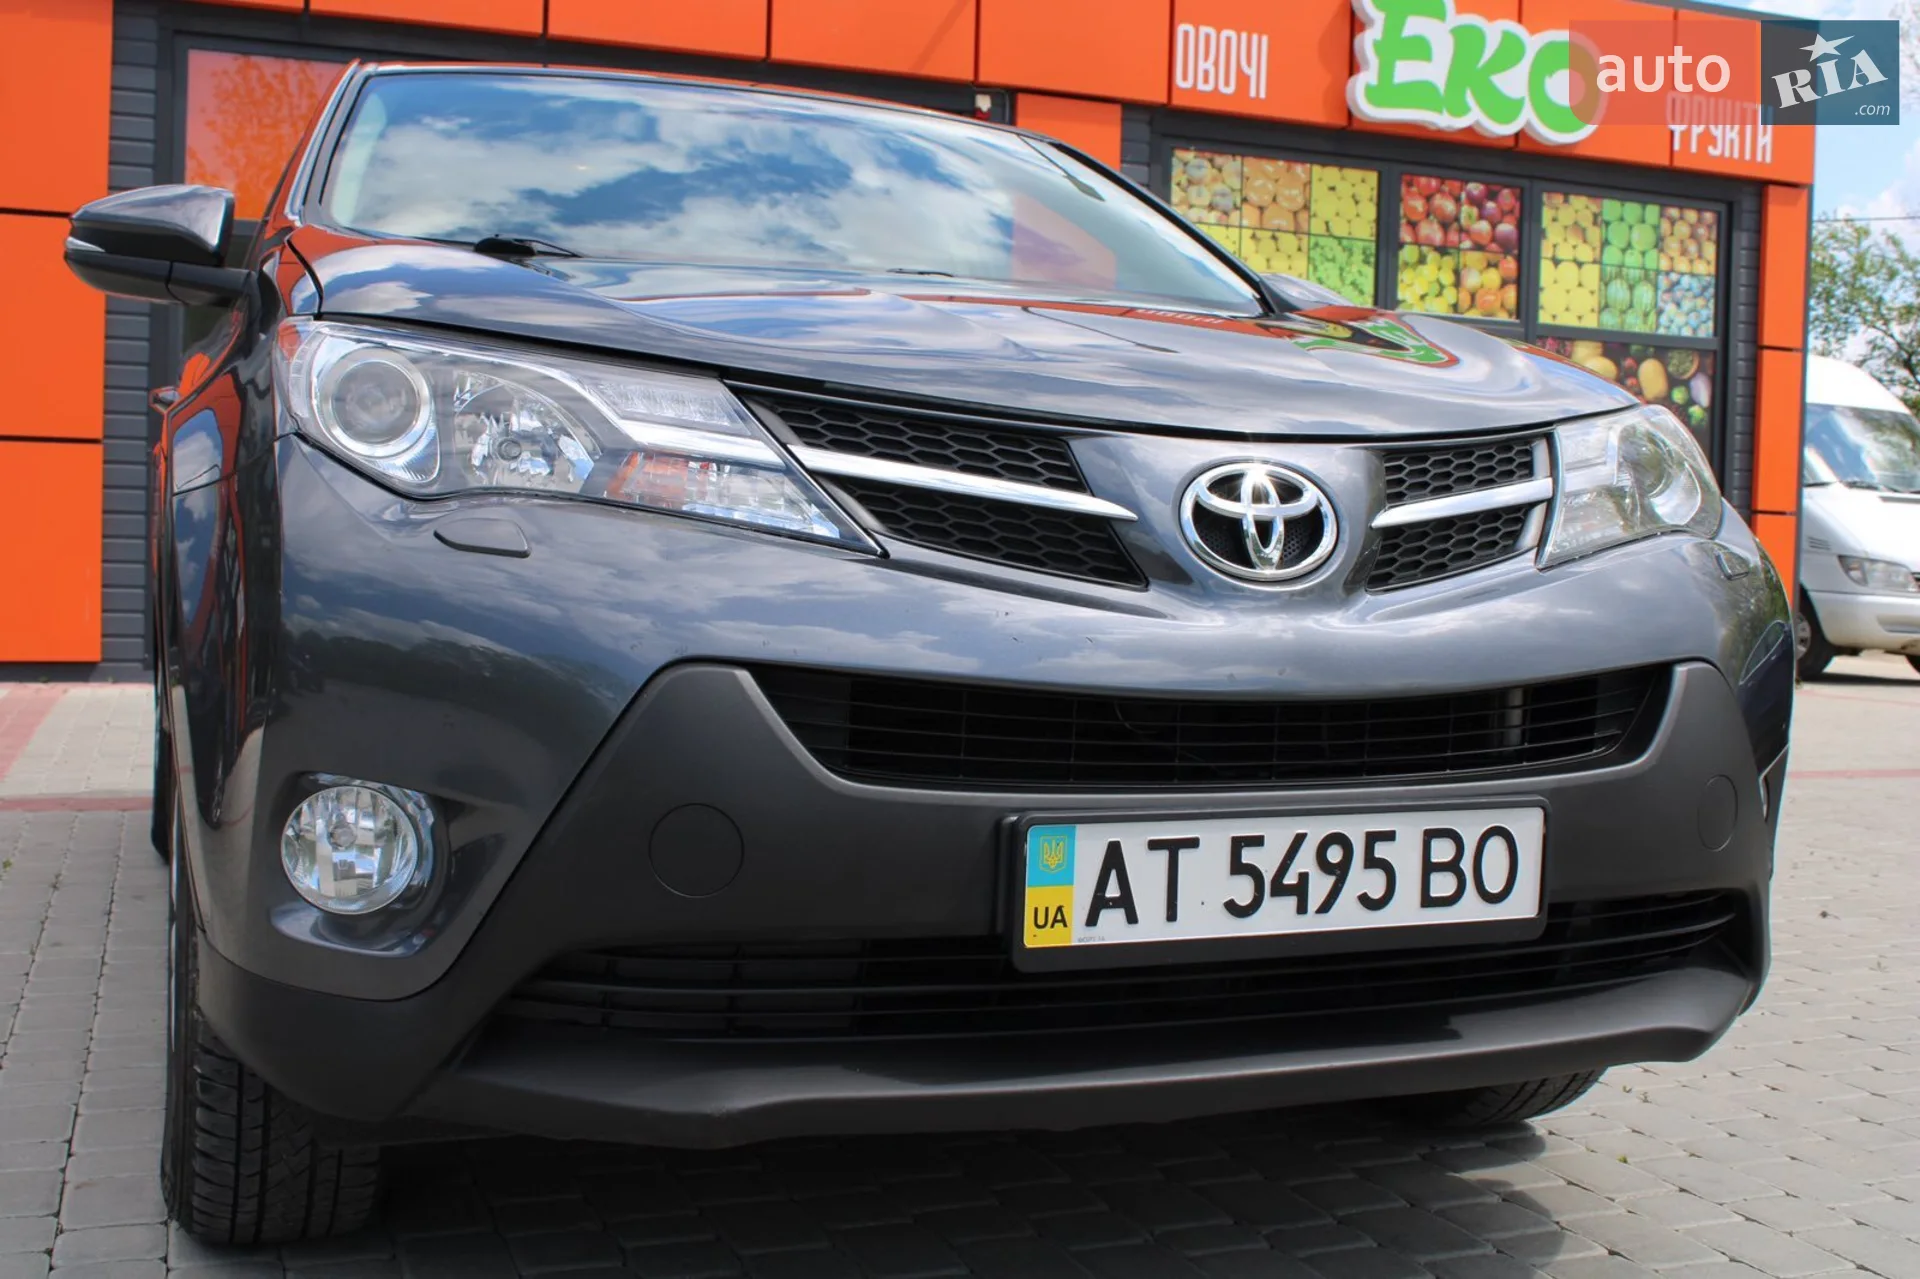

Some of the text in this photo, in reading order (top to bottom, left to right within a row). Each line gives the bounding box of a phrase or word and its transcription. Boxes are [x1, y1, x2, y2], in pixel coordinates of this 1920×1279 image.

[1175, 23, 1268, 99] ОВОЧІ
[1084, 836, 1201, 927] AT
[1223, 829, 1397, 919] 5495
[1033, 905, 1068, 929] UA
